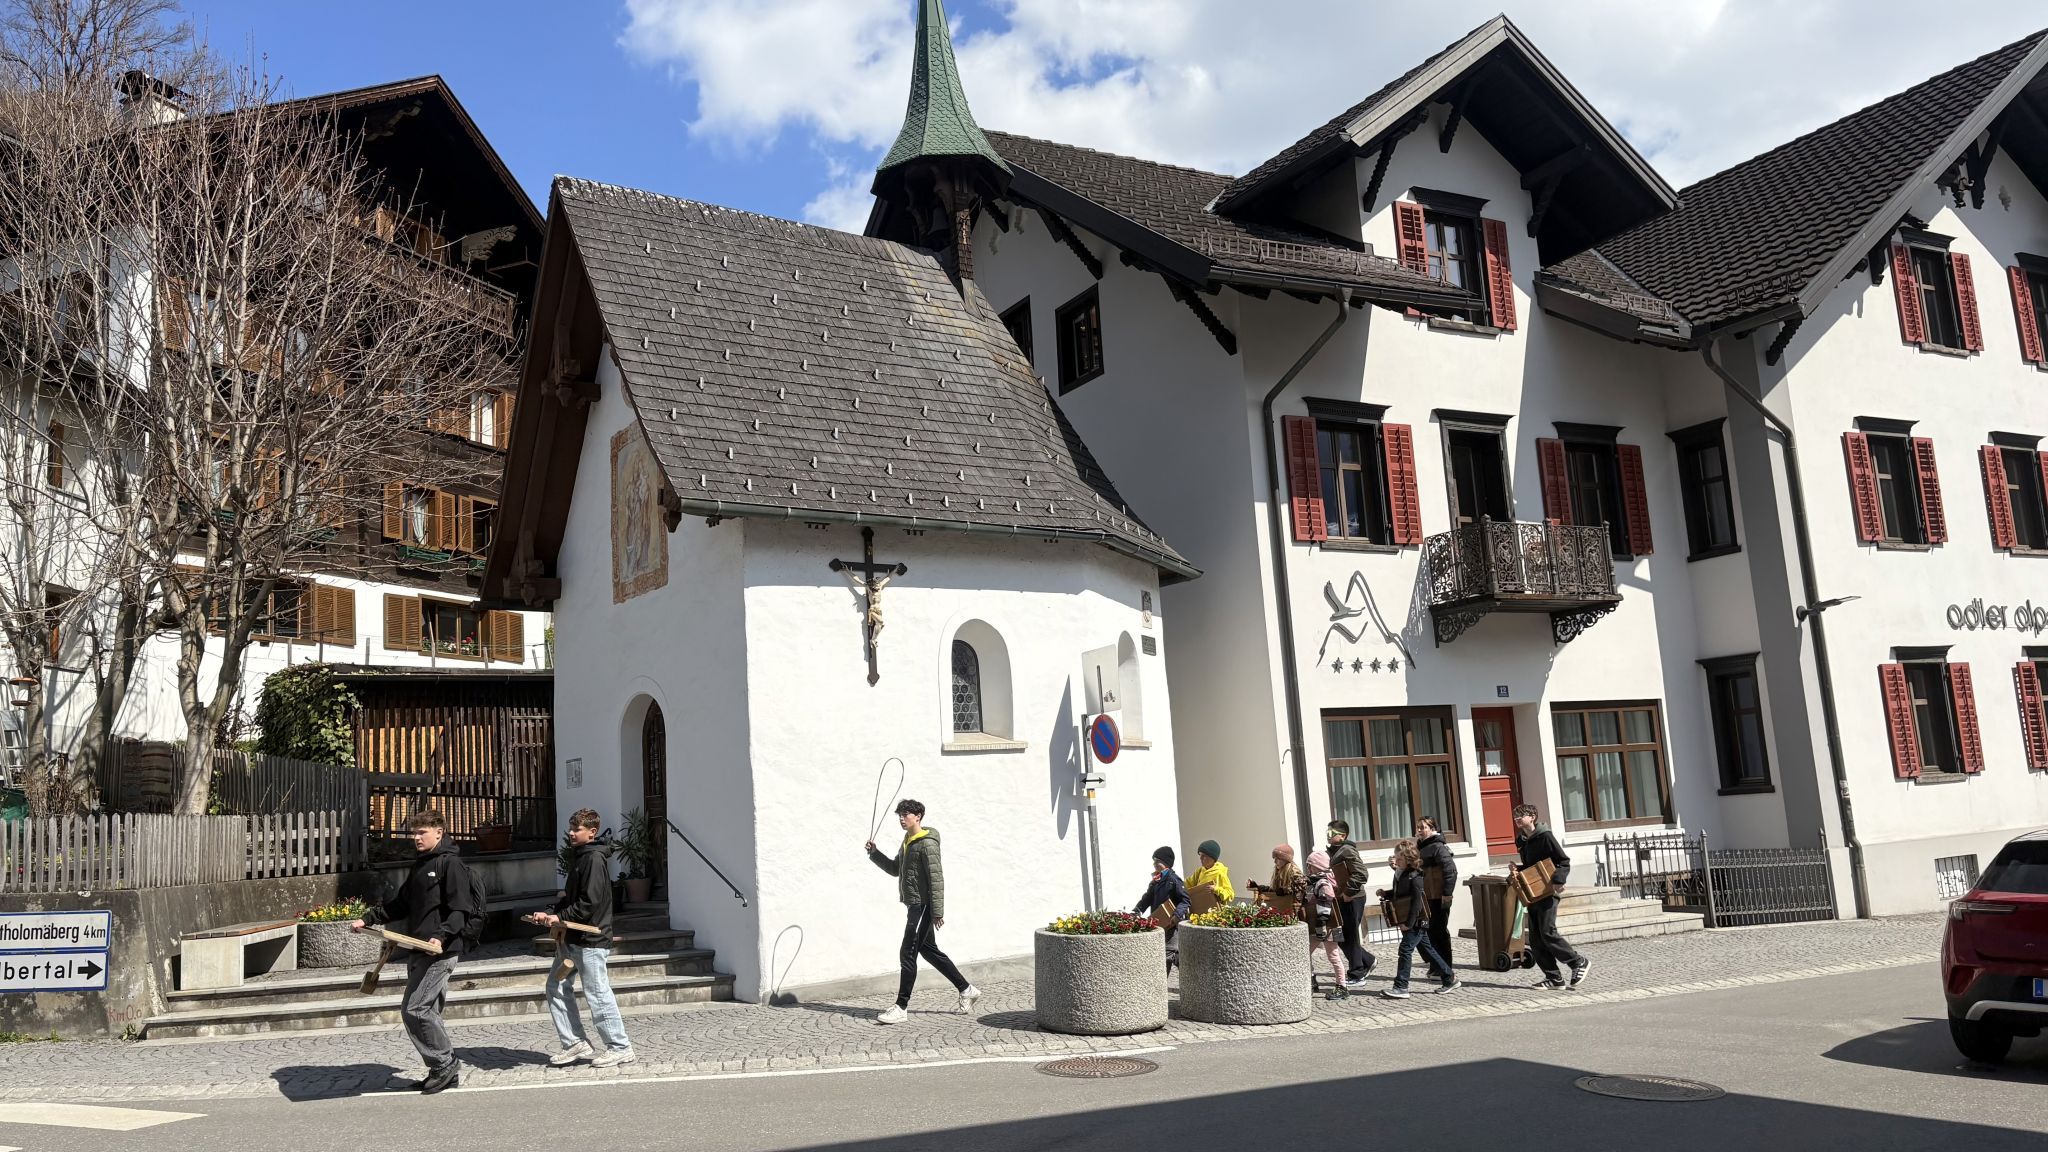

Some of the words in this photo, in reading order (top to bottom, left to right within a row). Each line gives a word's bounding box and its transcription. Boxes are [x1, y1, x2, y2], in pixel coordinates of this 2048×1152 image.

[1947, 598, 2008, 631] adler
[2014, 599, 2048, 638] alp
[0, 960, 73, 980] bertal
